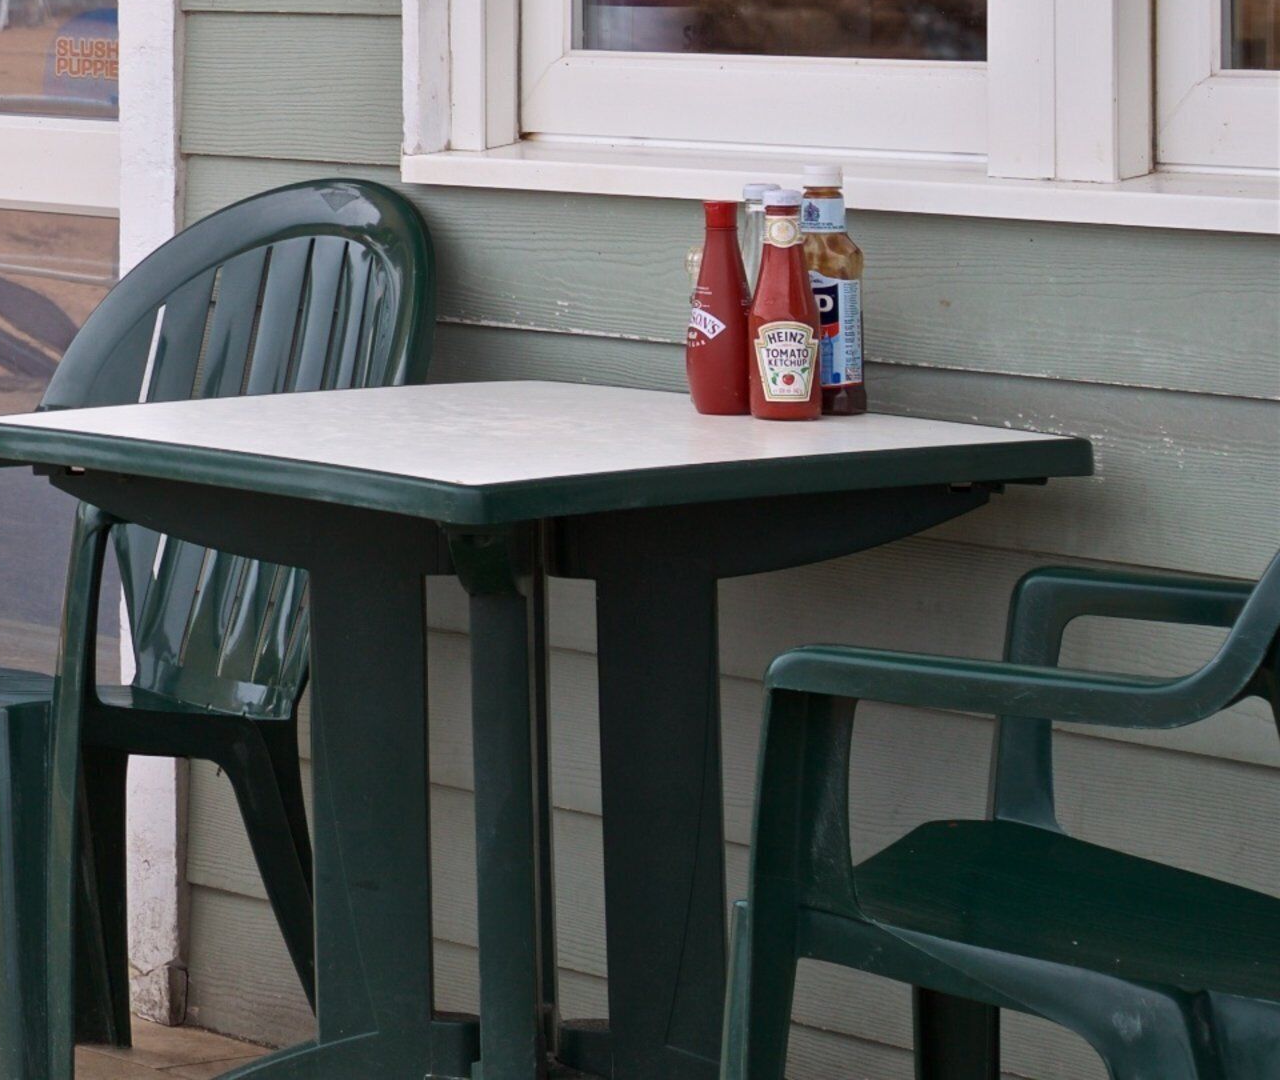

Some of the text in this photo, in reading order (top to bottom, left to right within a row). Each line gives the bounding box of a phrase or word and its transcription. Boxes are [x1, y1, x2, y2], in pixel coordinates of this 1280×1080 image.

[56, 37, 118, 59] SLUSH
[767, 330, 806, 346] HEINZ
[765, 347, 809, 359] TOMATO
[767, 358, 808, 368] KETCHUP
